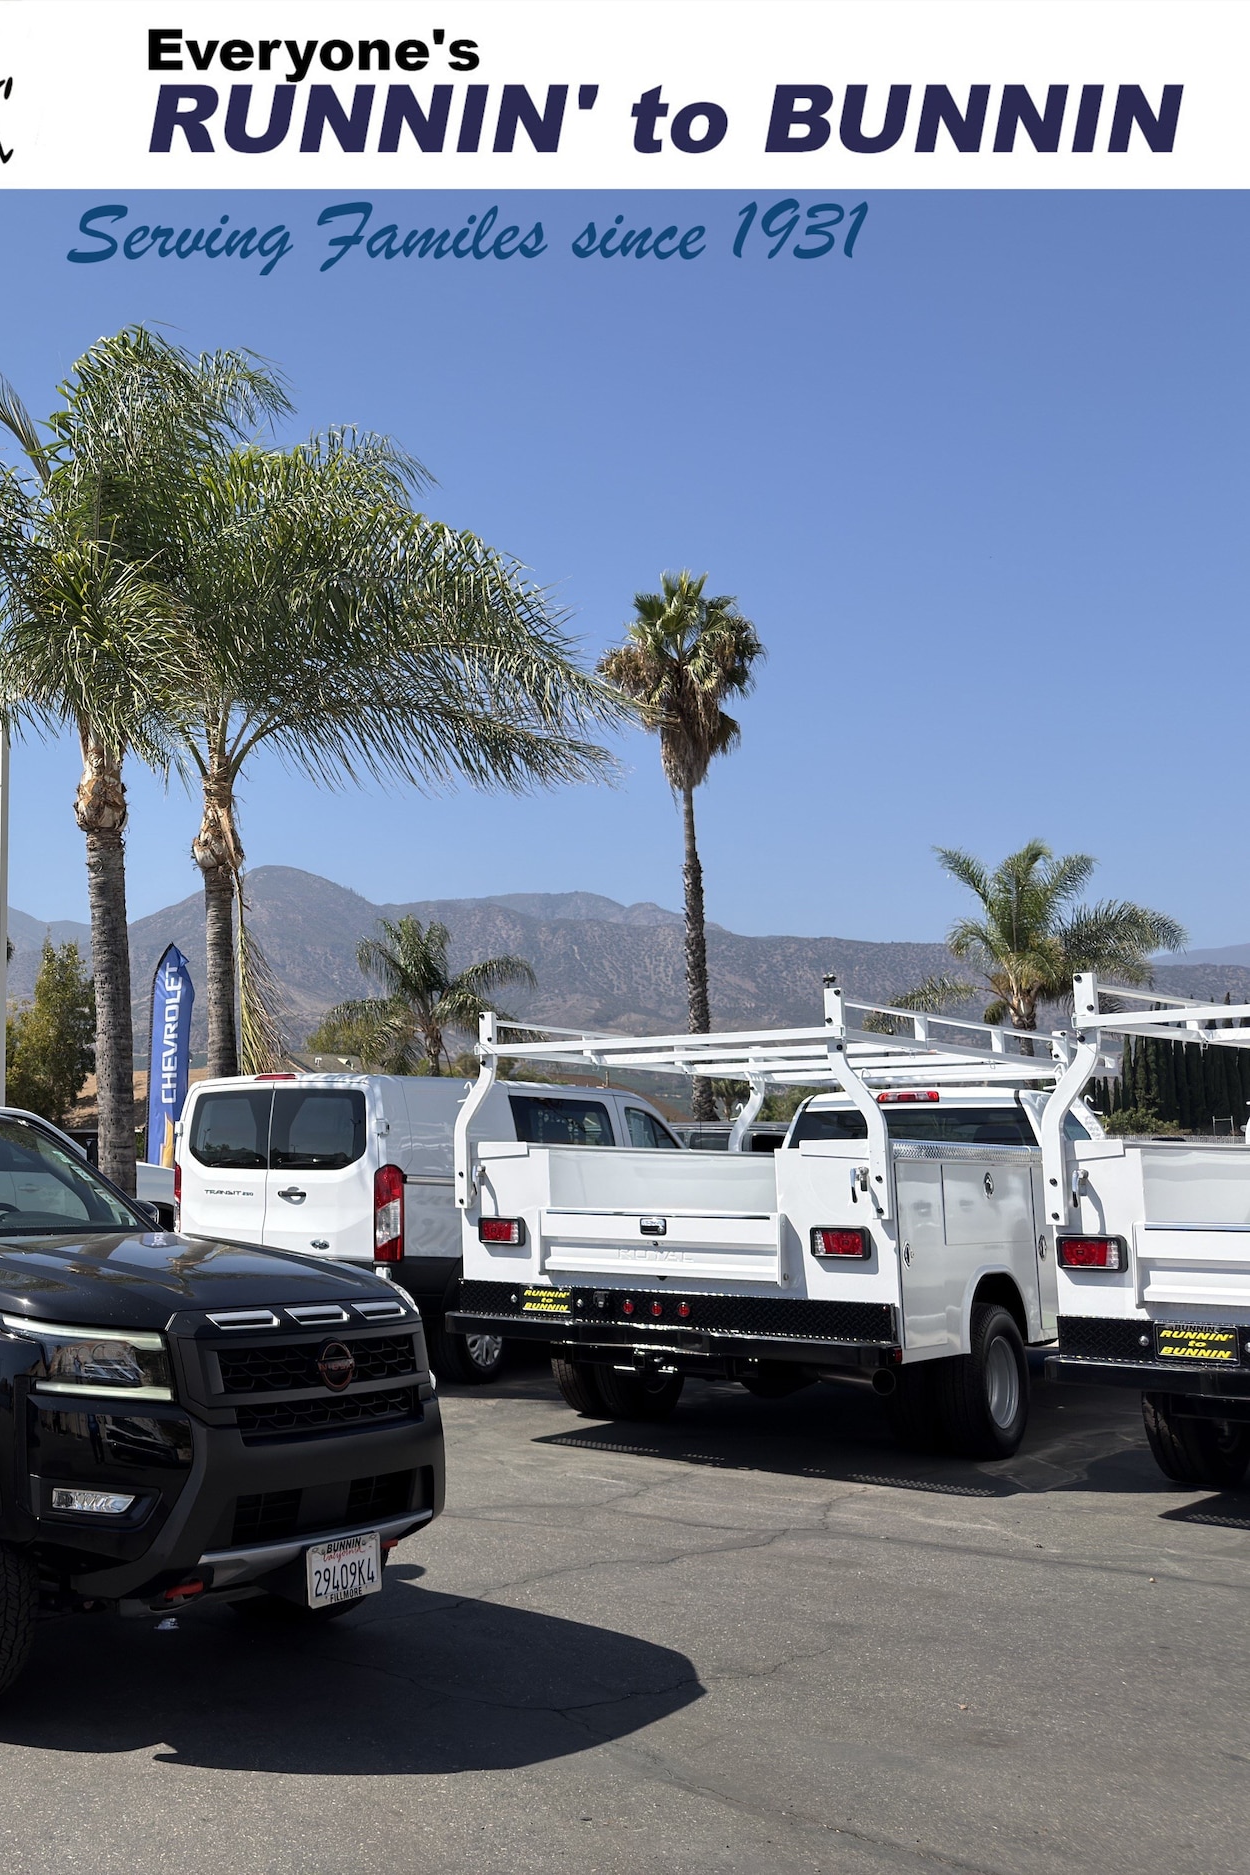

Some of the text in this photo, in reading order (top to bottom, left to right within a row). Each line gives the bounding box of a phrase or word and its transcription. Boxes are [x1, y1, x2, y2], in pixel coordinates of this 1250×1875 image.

[161, 962, 183, 1104] CHEVROLET
[618, 1249, 694, 1263] ROYAL
[523, 1289, 570, 1299] RUNNIN'
[524, 1302, 569, 1311] BUNNIN
[1159, 1329, 1235, 1342] RUNNIN'
[1188, 1340, 1207, 1348] to
[1160, 1346, 1232, 1359] BUNNIN
[326, 1537, 362, 1554] BUNNIN
[314, 1558, 375, 1598] 29409K4
[330, 1586, 363, 1603] FILLMORE
